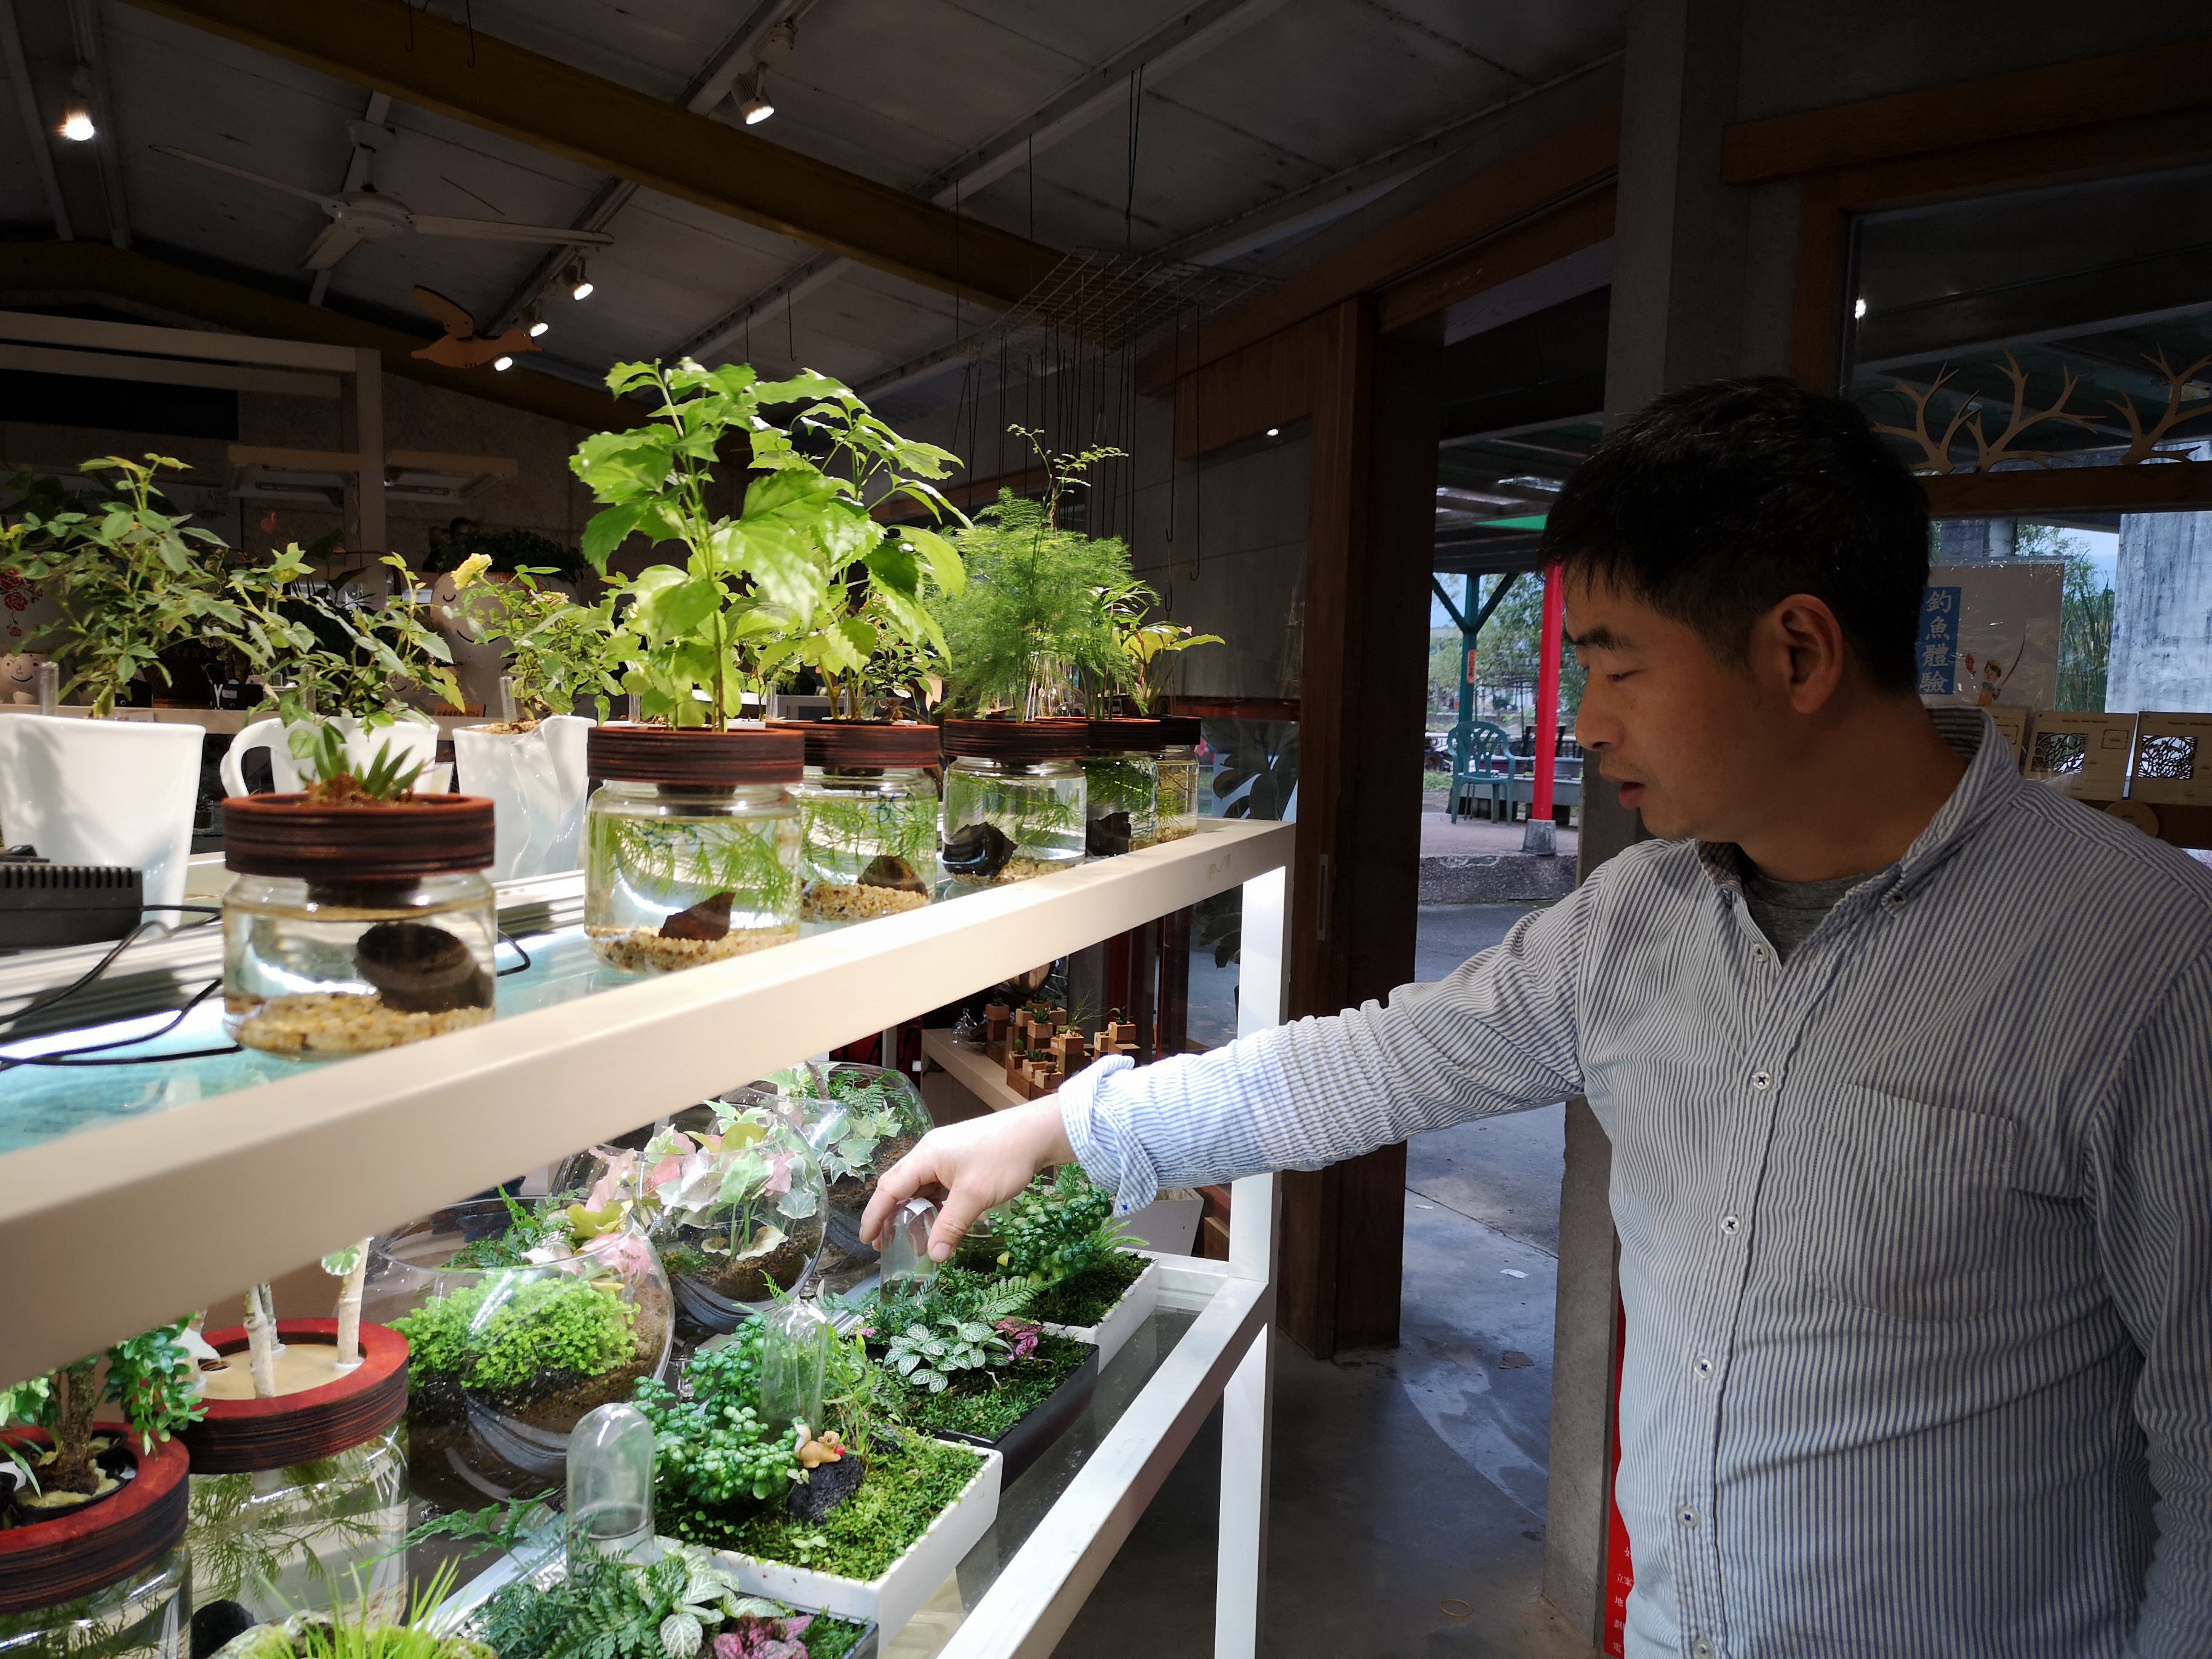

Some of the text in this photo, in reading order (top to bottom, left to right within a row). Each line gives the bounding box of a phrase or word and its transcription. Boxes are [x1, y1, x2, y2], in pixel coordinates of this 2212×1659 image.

[1919, 590, 1952, 693] 釣魚體驗
[1617, 1572, 1634, 1587] 立案
